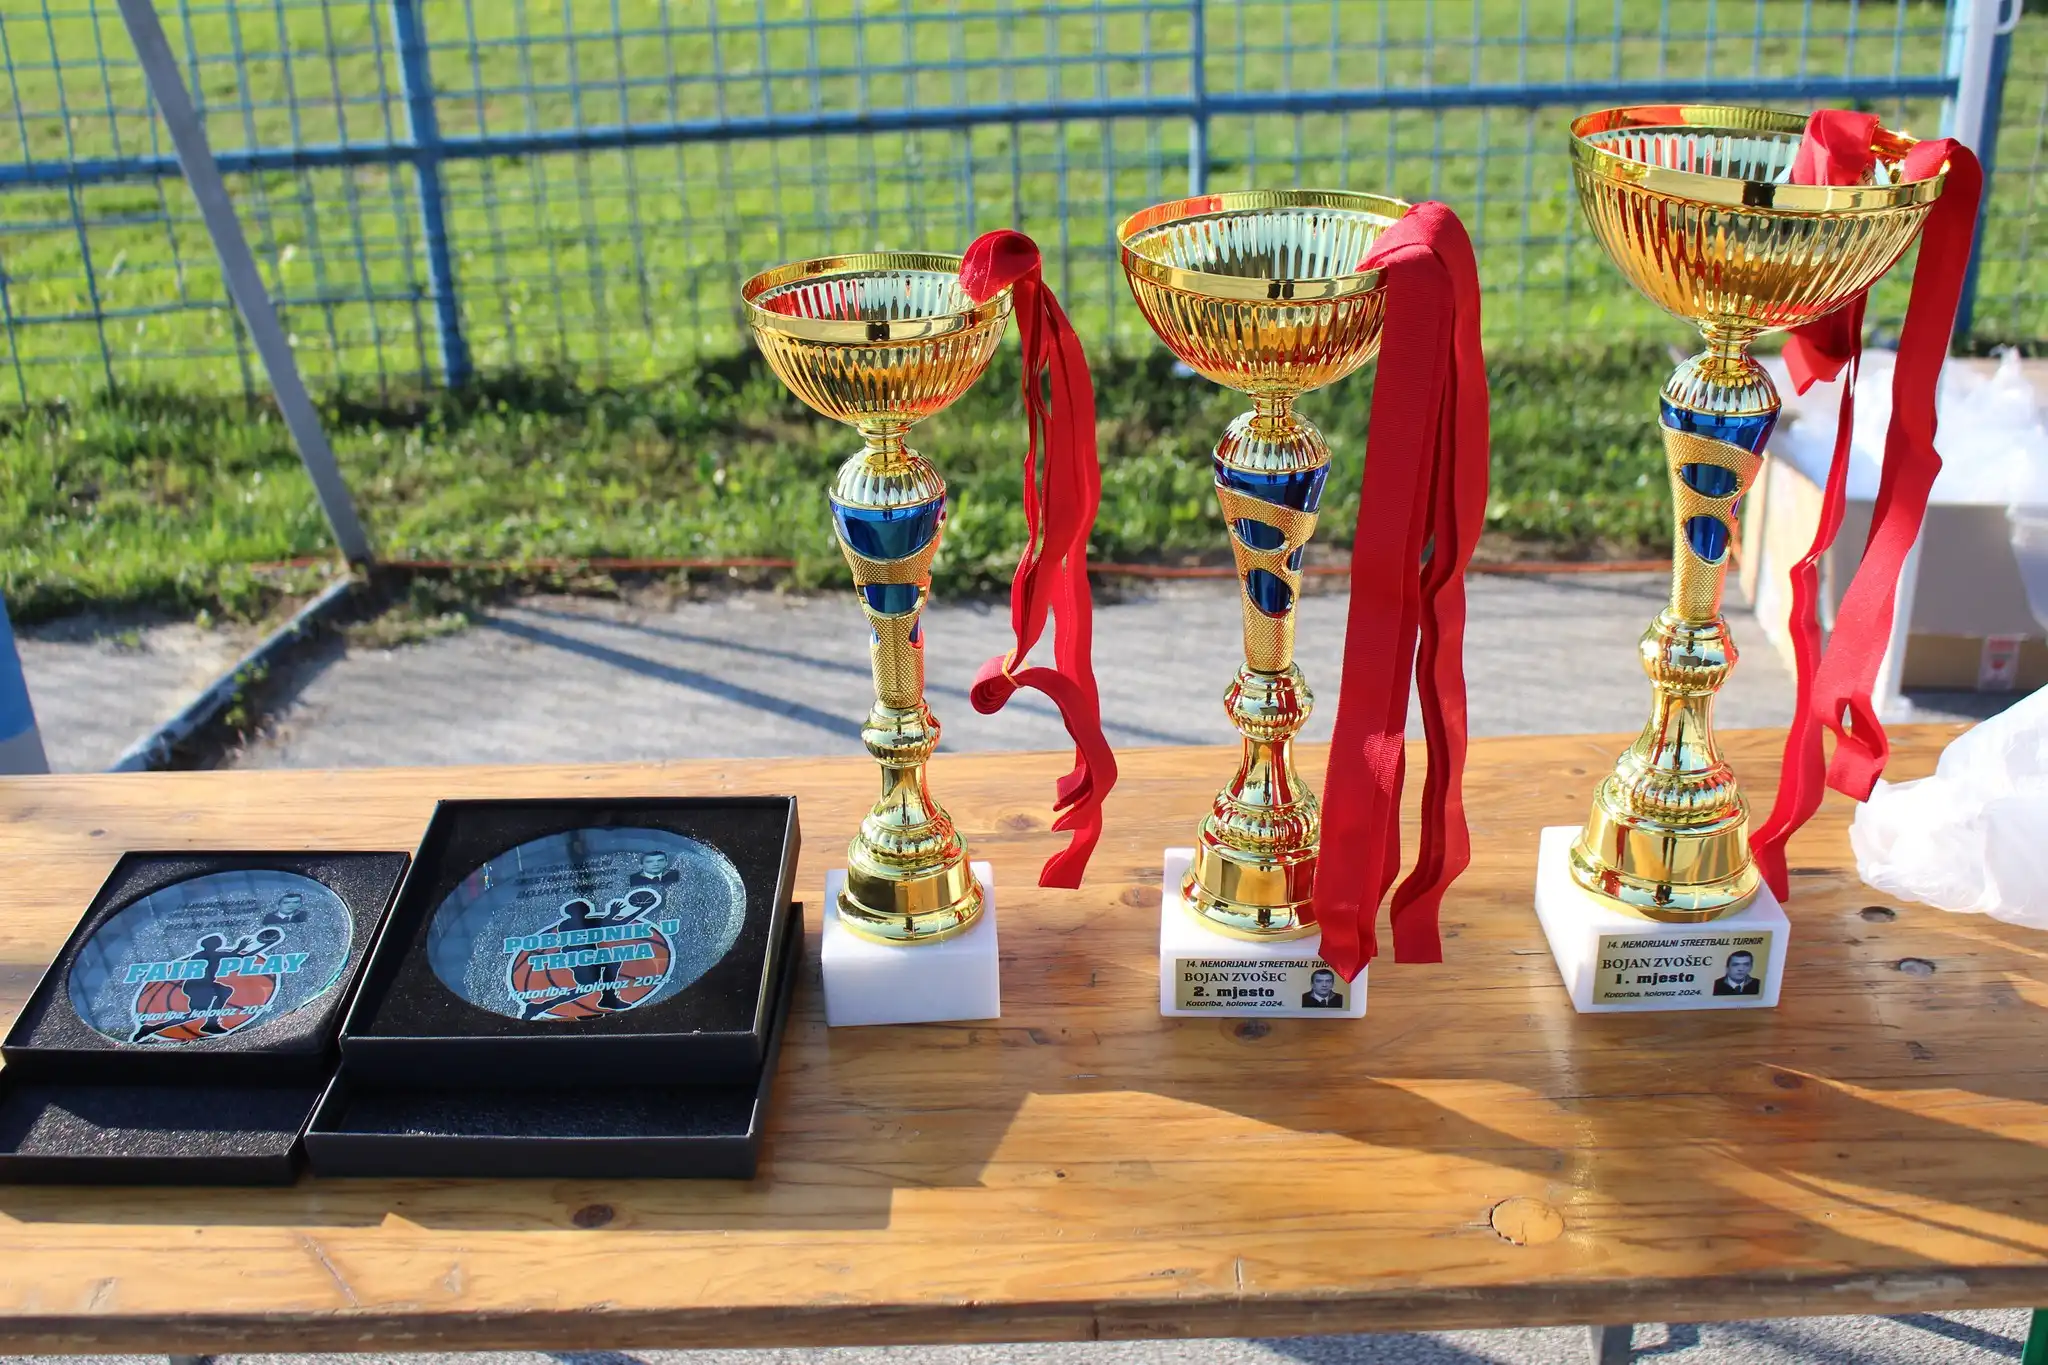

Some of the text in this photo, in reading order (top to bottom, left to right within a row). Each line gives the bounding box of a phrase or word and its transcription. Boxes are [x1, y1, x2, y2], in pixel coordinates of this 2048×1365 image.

[503, 919, 680, 953] POBJEDNIK U
[1607, 937, 1764, 949] 14. MEMORIJALNI STREETBALL TURNIR
[528, 943, 655, 971] TRICAMA
[1186, 960, 1330, 968] 14. MEMORIJALNI STREETBALL TUR
[1602, 955, 1713, 971] BOJAN ZVOŠEC
[123, 953, 310, 983] FAIR PLAY
[1184, 969, 1287, 985] BOJAN ZVOŠEC
[1615, 973, 1695, 986] 1. mjesto
[507, 985, 571, 1001] Kotoriba,
[575, 979, 629, 994] kolovoz
[1193, 986, 1275, 999] 2. mjesto
[1643, 990, 1676, 998] kolovoz
[1677, 989, 1703, 997] 2024.
[1185, 1000, 1285, 1008] Kotoriba, kolovoz 2024.
